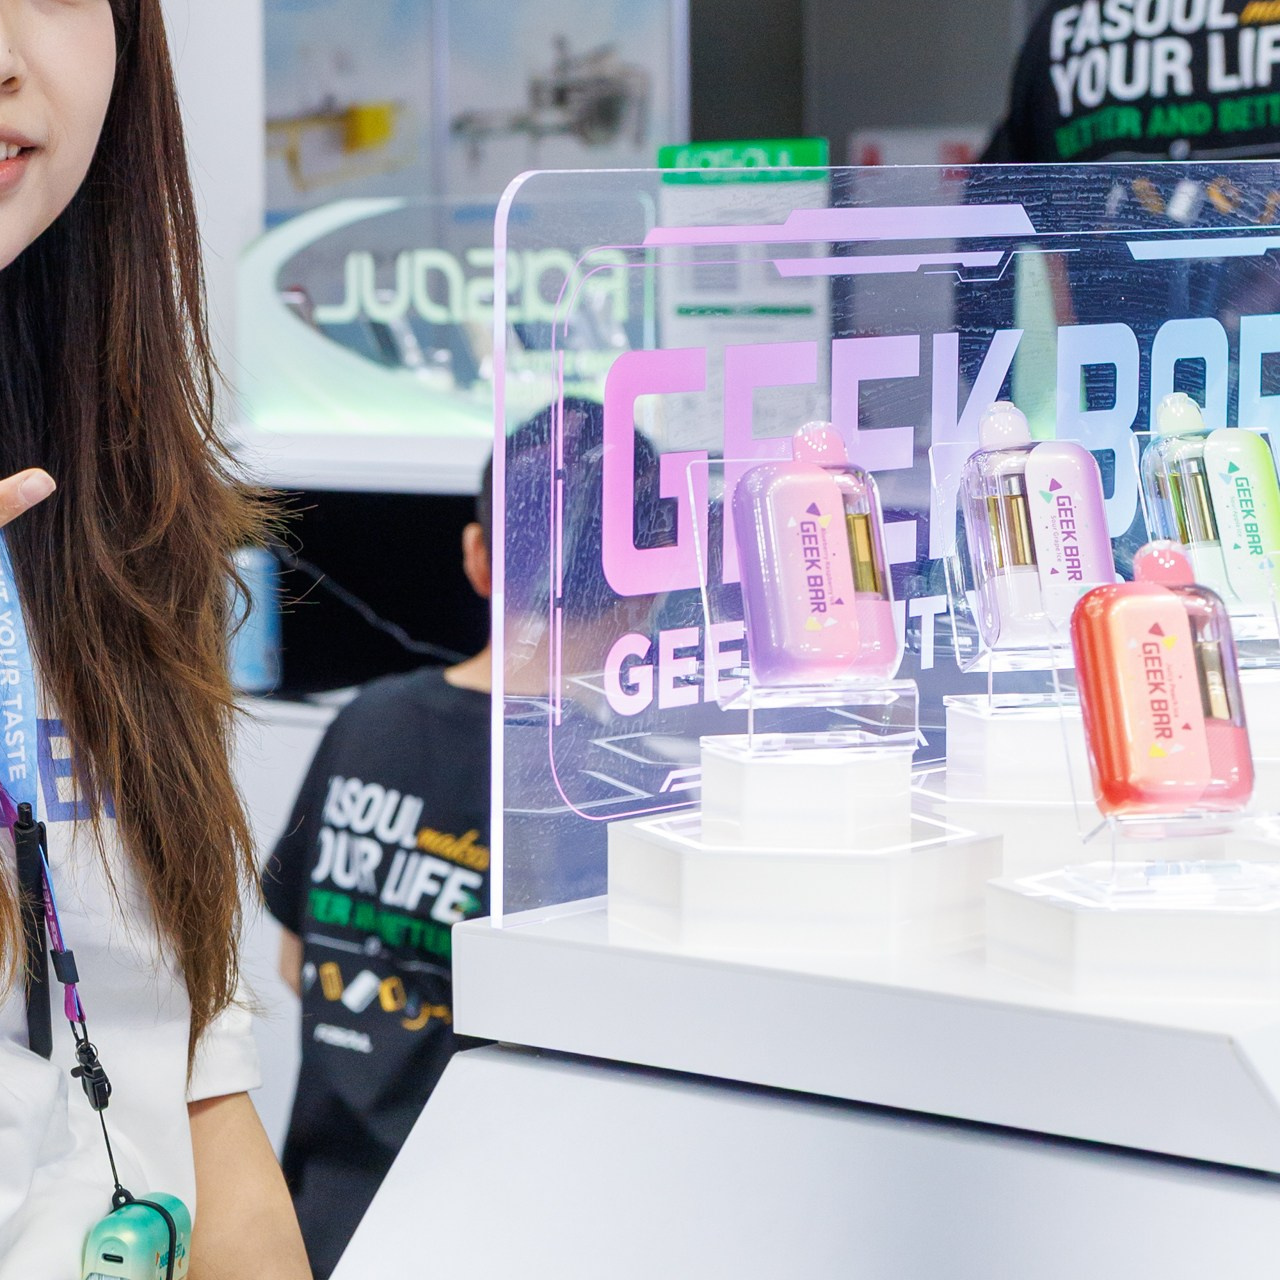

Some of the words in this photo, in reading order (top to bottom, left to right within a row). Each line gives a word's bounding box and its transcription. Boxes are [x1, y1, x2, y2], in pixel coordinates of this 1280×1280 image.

[1049, 36, 1194, 117] YOUR
[1207, 26, 1280, 94] LIF
[602, 330, 1024, 597] GEEK
[1056, 495, 1077, 542] GEEK
[1235, 477, 1256, 519] GEEK
[800, 521, 822, 571] GEEK
[1064, 546, 1083, 581] BAR
[1244, 523, 1264, 556] BAR
[807, 575, 827, 613] BAR
[604, 621, 745, 716] GEE
[1142, 642, 1167, 695] GEEK
[2, 692, 27, 782] TASTE
[1150, 699, 1173, 739] BAR
[380, 849, 483, 926] LIFE
